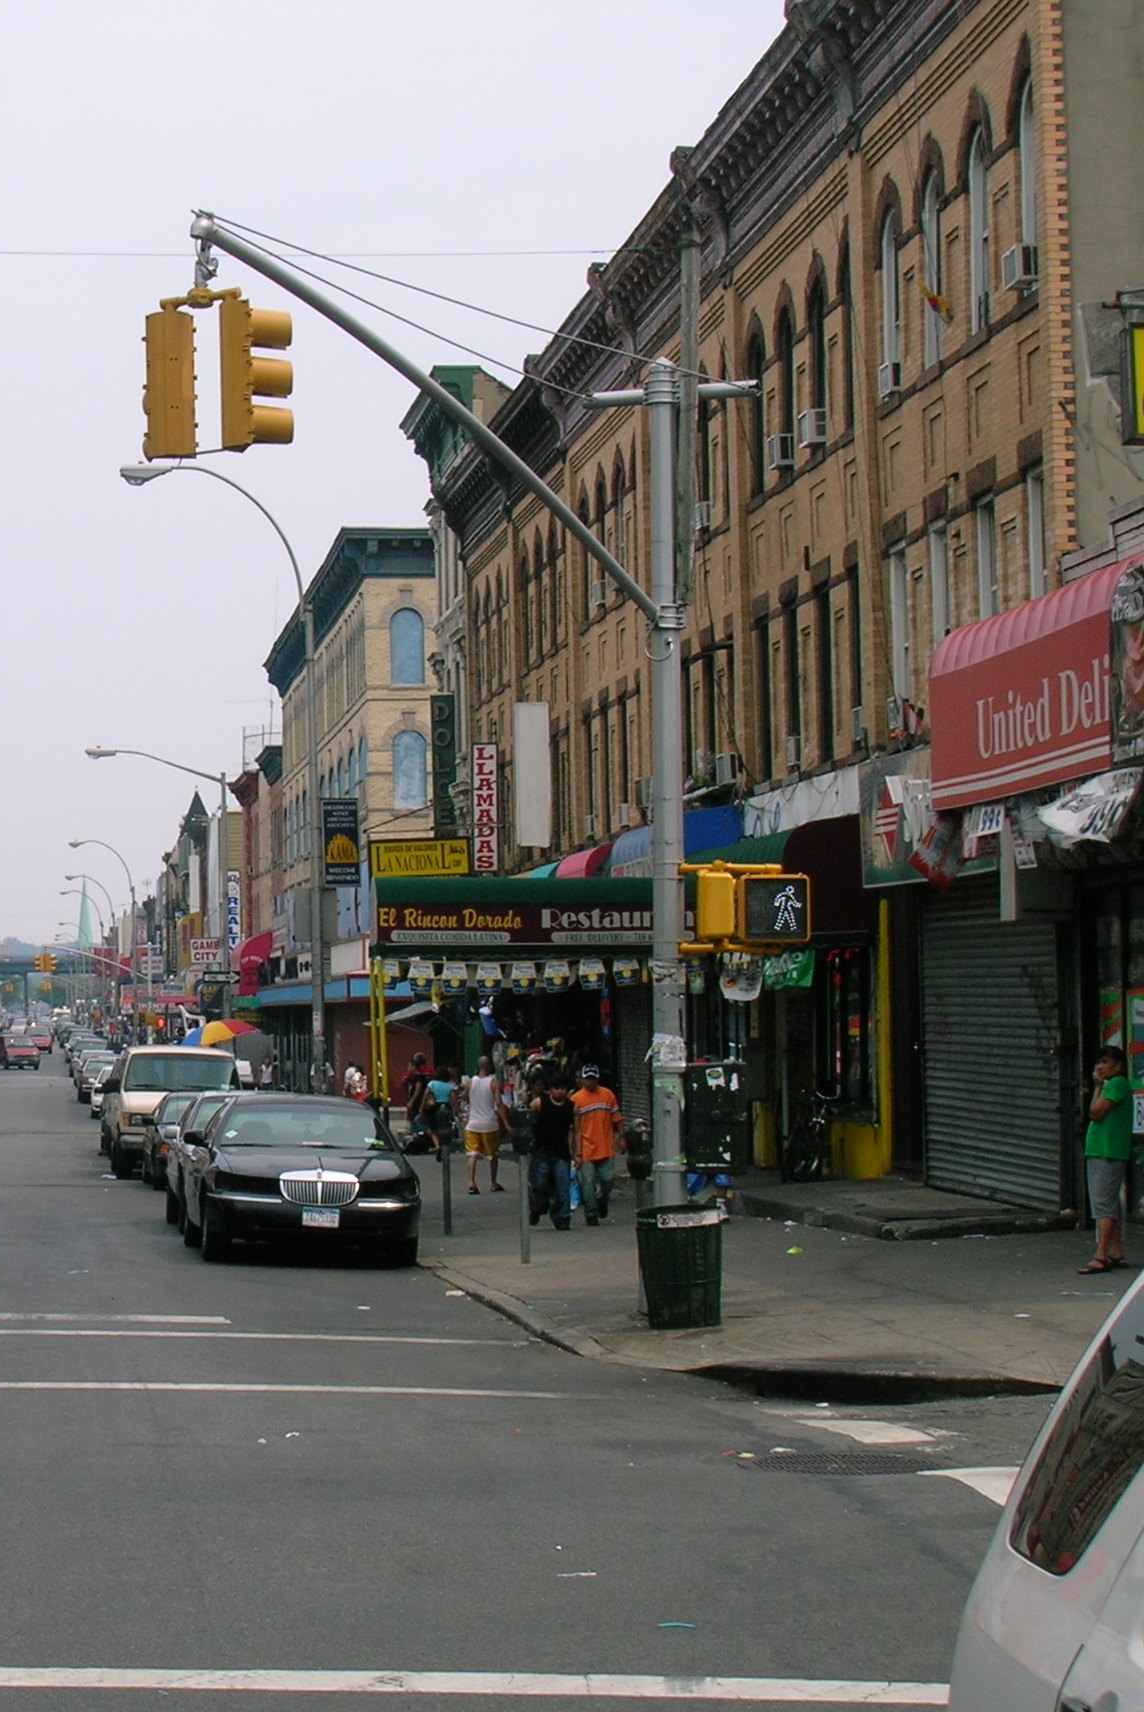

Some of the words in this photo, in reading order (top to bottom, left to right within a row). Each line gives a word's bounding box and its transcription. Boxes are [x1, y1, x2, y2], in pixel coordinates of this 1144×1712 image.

[1059, 654, 1110, 736] Deli
[976, 678, 1051, 759] United
[433, 702, 451, 824] DOLCE
[476, 747, 495, 869] LLAMADAS
[375, 846, 393, 873] LA
[395, 843, 451, 871] NACIONAL
[378, 907, 397, 928] El
[404, 907, 458, 929] Rincon
[462, 908, 523, 929] Dorado
[542, 907, 697, 929] Restaurn
[192, 941, 220, 951] GAME
[397, 931, 439, 943] EXQUISITA
[440, 931, 472, 942] COMIDA
[473, 932, 505, 943] LATINA
[193, 952, 218, 961] CITY
